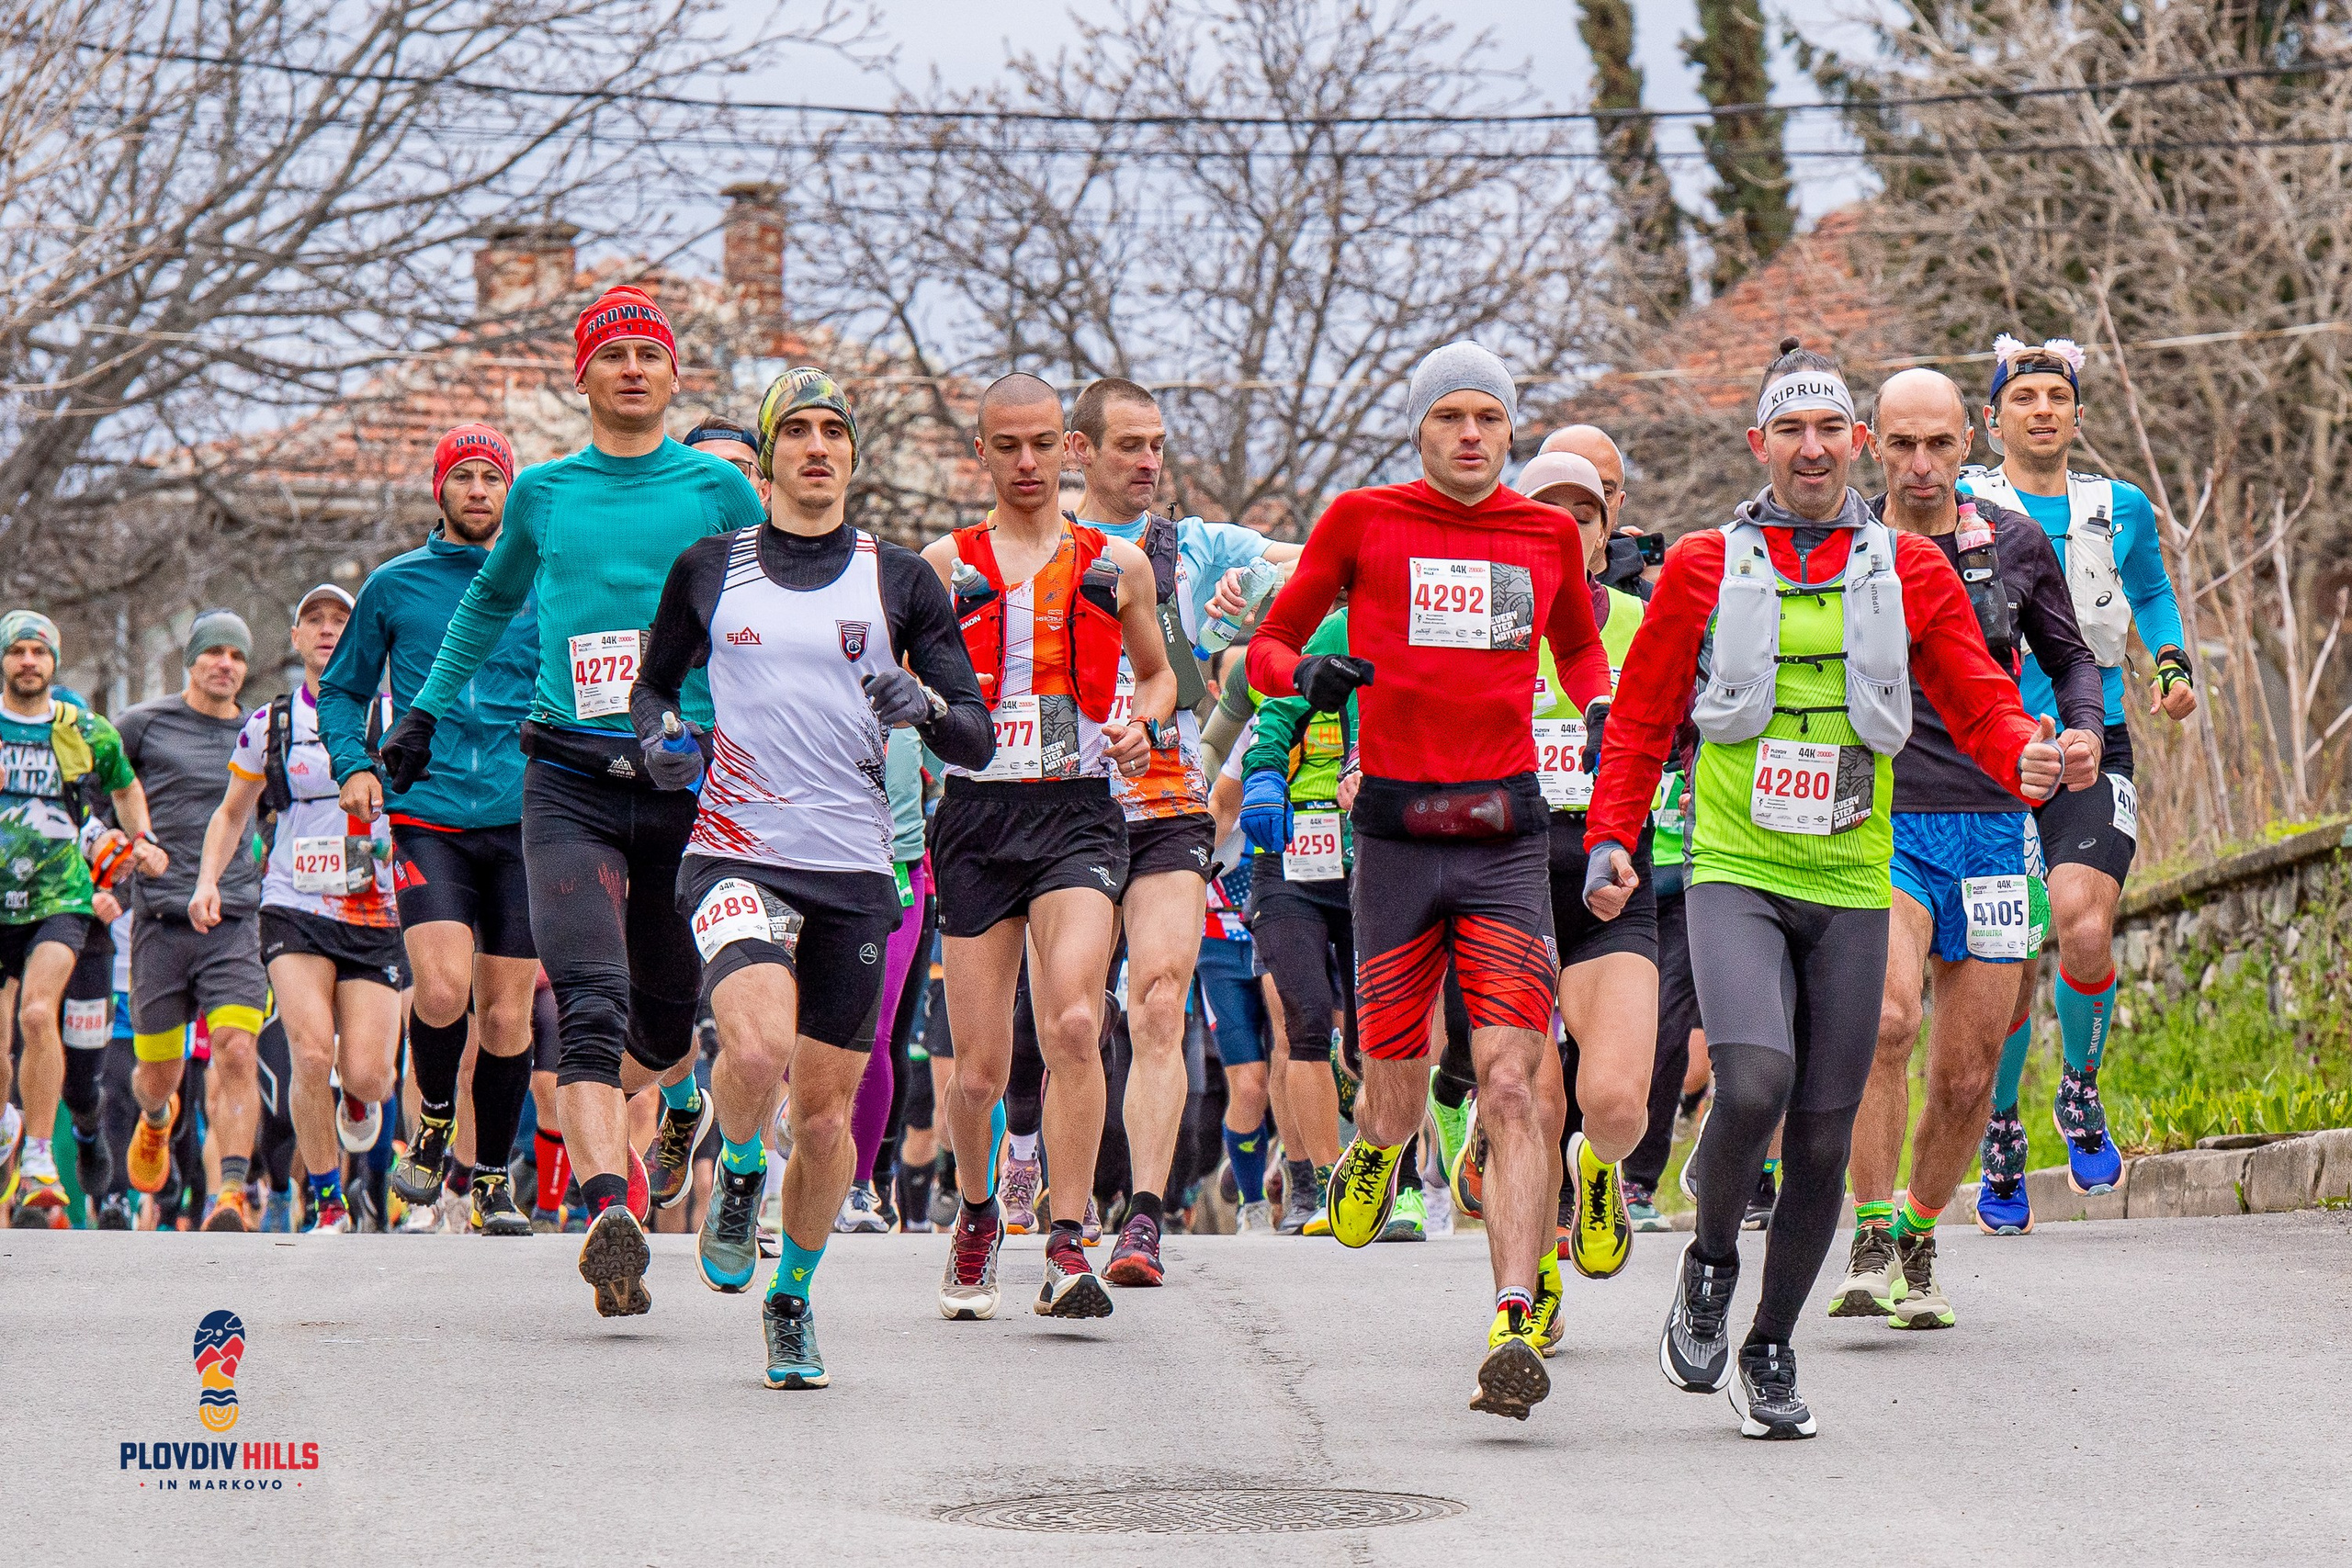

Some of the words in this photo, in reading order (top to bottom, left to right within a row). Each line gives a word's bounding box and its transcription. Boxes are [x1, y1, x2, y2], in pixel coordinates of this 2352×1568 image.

[1770, 383, 1835, 406] KIPRUN
[1451, 564, 1467, 574] 44K
[1415, 583, 1485, 614] 4292
[1871, 583, 1881, 615] KIPRUN
[1491, 620, 1514, 635] STEP
[1493, 625, 1533, 643] MATTERS
[601, 636, 617, 646] 44K
[575, 655, 634, 685] 4272
[1001, 700, 1018, 710] 44K
[1561, 724, 1577, 734] 44K
[1042, 750, 1063, 764] STEP
[1043, 751, 1080, 772] MATTERS
[1798, 747, 1816, 759] 44K
[1756, 766, 1830, 801] 4280
[1833, 795, 1859, 812] EVERY
[1833, 806, 1855, 820] STEP
[1834, 807, 1872, 829] MATTERS
[1286, 833, 1336, 856] 4259
[295, 854, 340, 874] 4279
[718, 881, 736, 891] 44K
[1997, 880, 2012, 890] 44K
[695, 896, 759, 935] 4289
[1973, 899, 2024, 926] 4105
[1985, 929, 2003, 937] ULTRA
